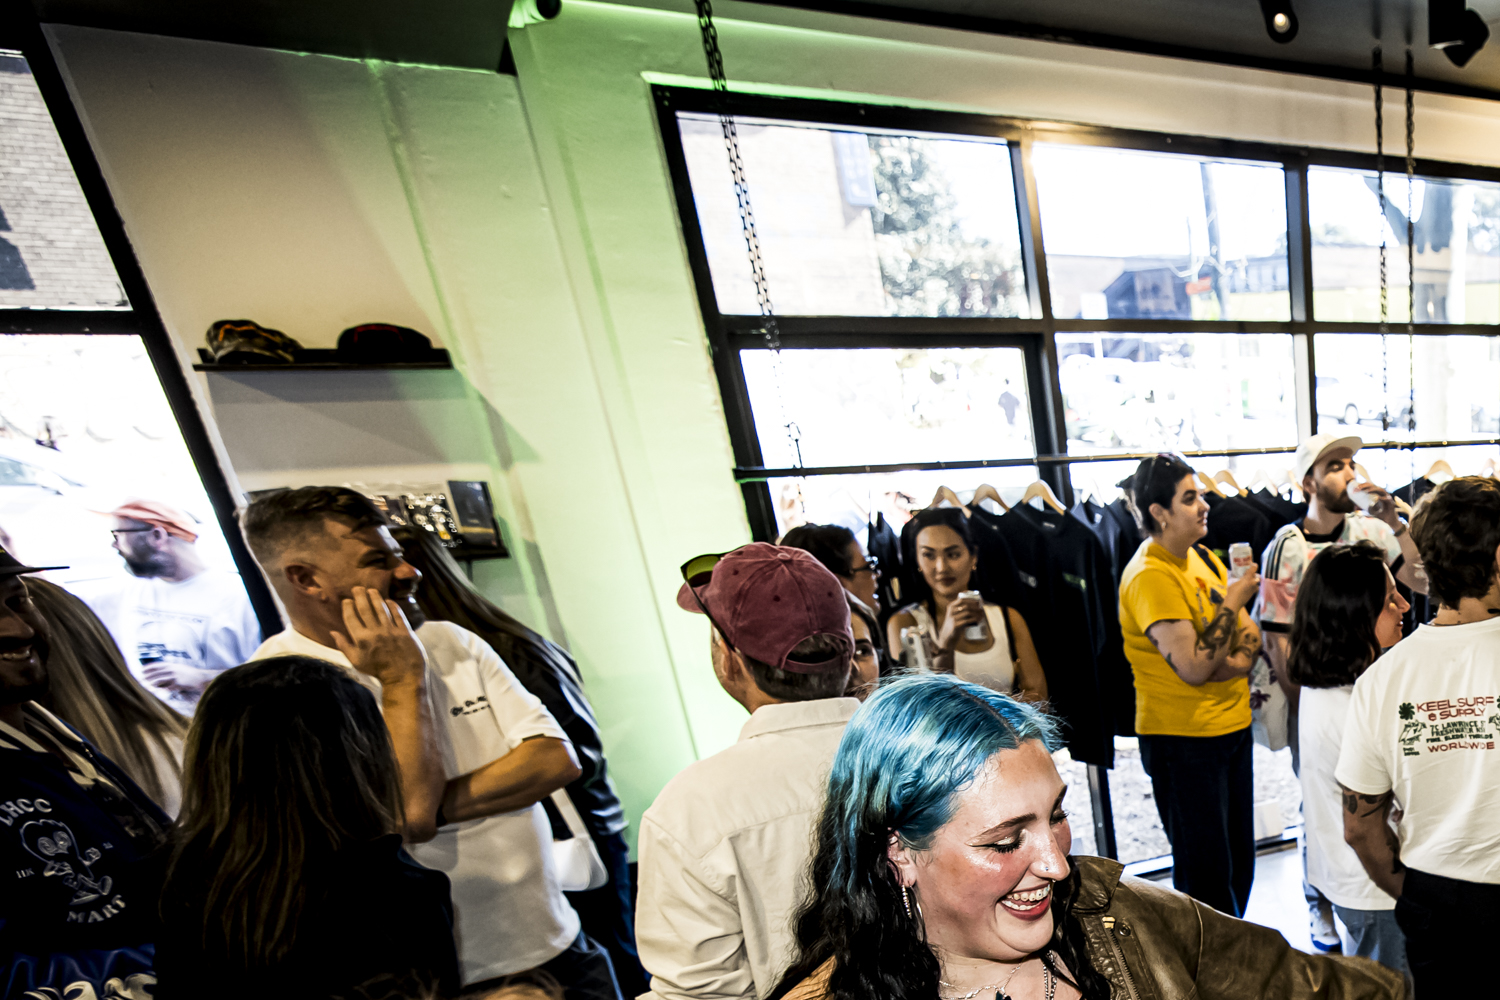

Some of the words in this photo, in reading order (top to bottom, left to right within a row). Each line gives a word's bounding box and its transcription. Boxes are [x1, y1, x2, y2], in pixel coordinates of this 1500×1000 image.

[1416, 699, 1457, 713] KEEL
[1457, 696, 1495, 708] SURF
[1439, 708, 1486, 720] SUPPLY
[66, 894, 126, 923] MART
